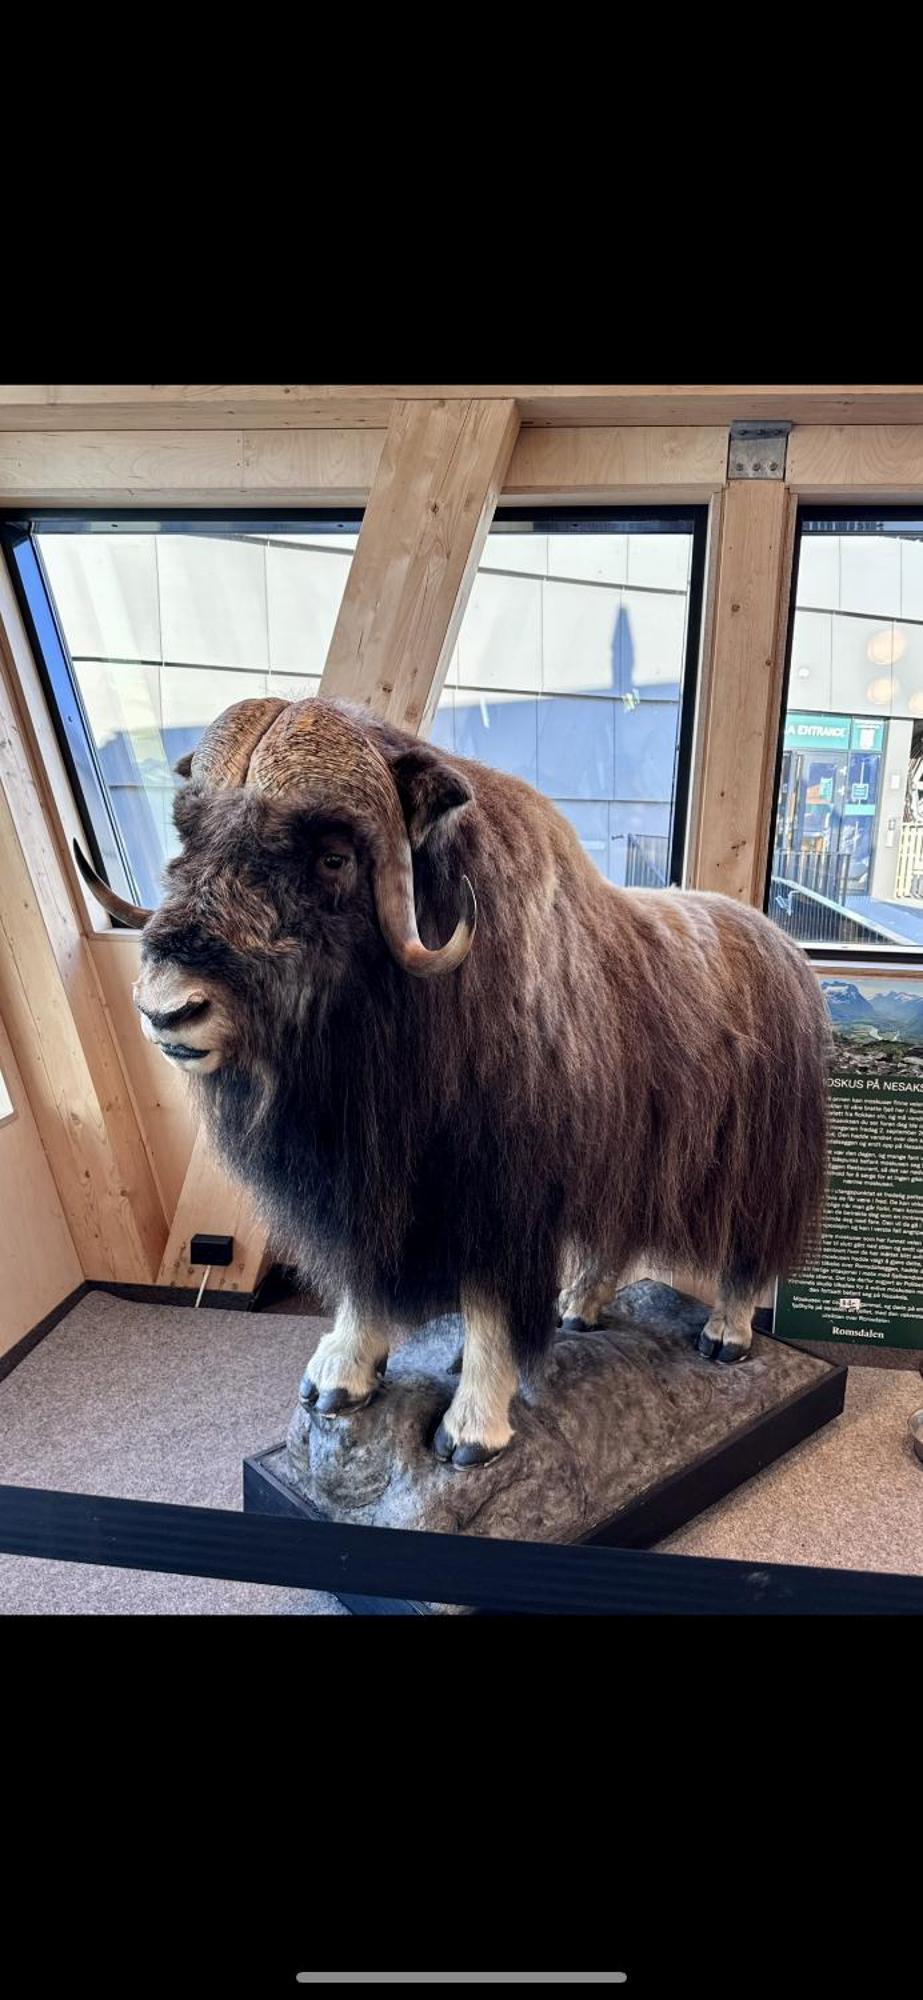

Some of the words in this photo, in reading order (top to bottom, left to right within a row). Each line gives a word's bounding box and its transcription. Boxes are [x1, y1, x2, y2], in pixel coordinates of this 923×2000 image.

[797, 725, 847, 738] ENTRANCE
[866, 1078, 880, 1090] PÅ
[832, 1326, 886, 1339] Romsdalen
